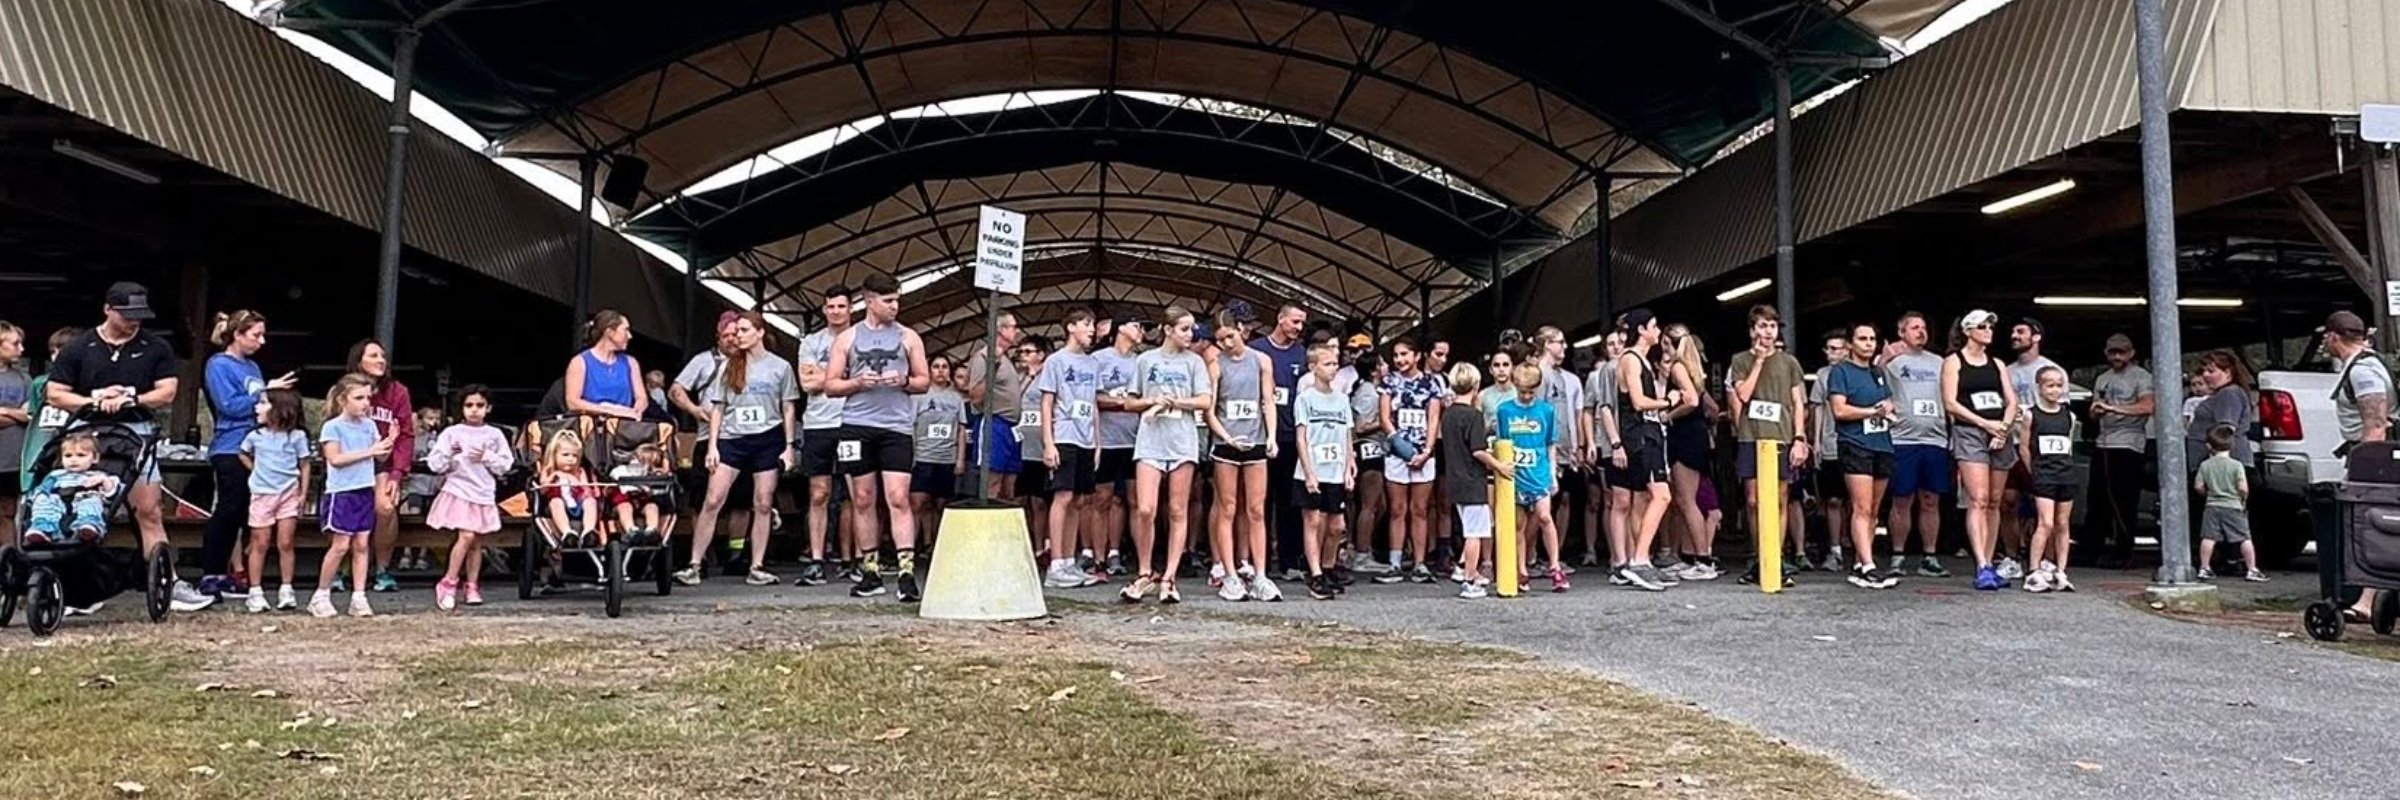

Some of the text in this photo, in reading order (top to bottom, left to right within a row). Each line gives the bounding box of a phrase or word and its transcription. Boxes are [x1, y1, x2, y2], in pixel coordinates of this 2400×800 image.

[993, 220, 1012, 234] NO
[982, 233, 1019, 248] PARKING
[1234, 403, 1252, 416] 76
[1755, 404, 1774, 418] 45
[1919, 401, 1935, 415] 38
[43, 409, 62, 423] 14
[742, 409, 759, 422] 51
[1401, 412, 1424, 424] 117
[933, 426, 948, 437] 96
[2045, 439, 2064, 451] 73
[1321, 446, 1338, 460] 75
